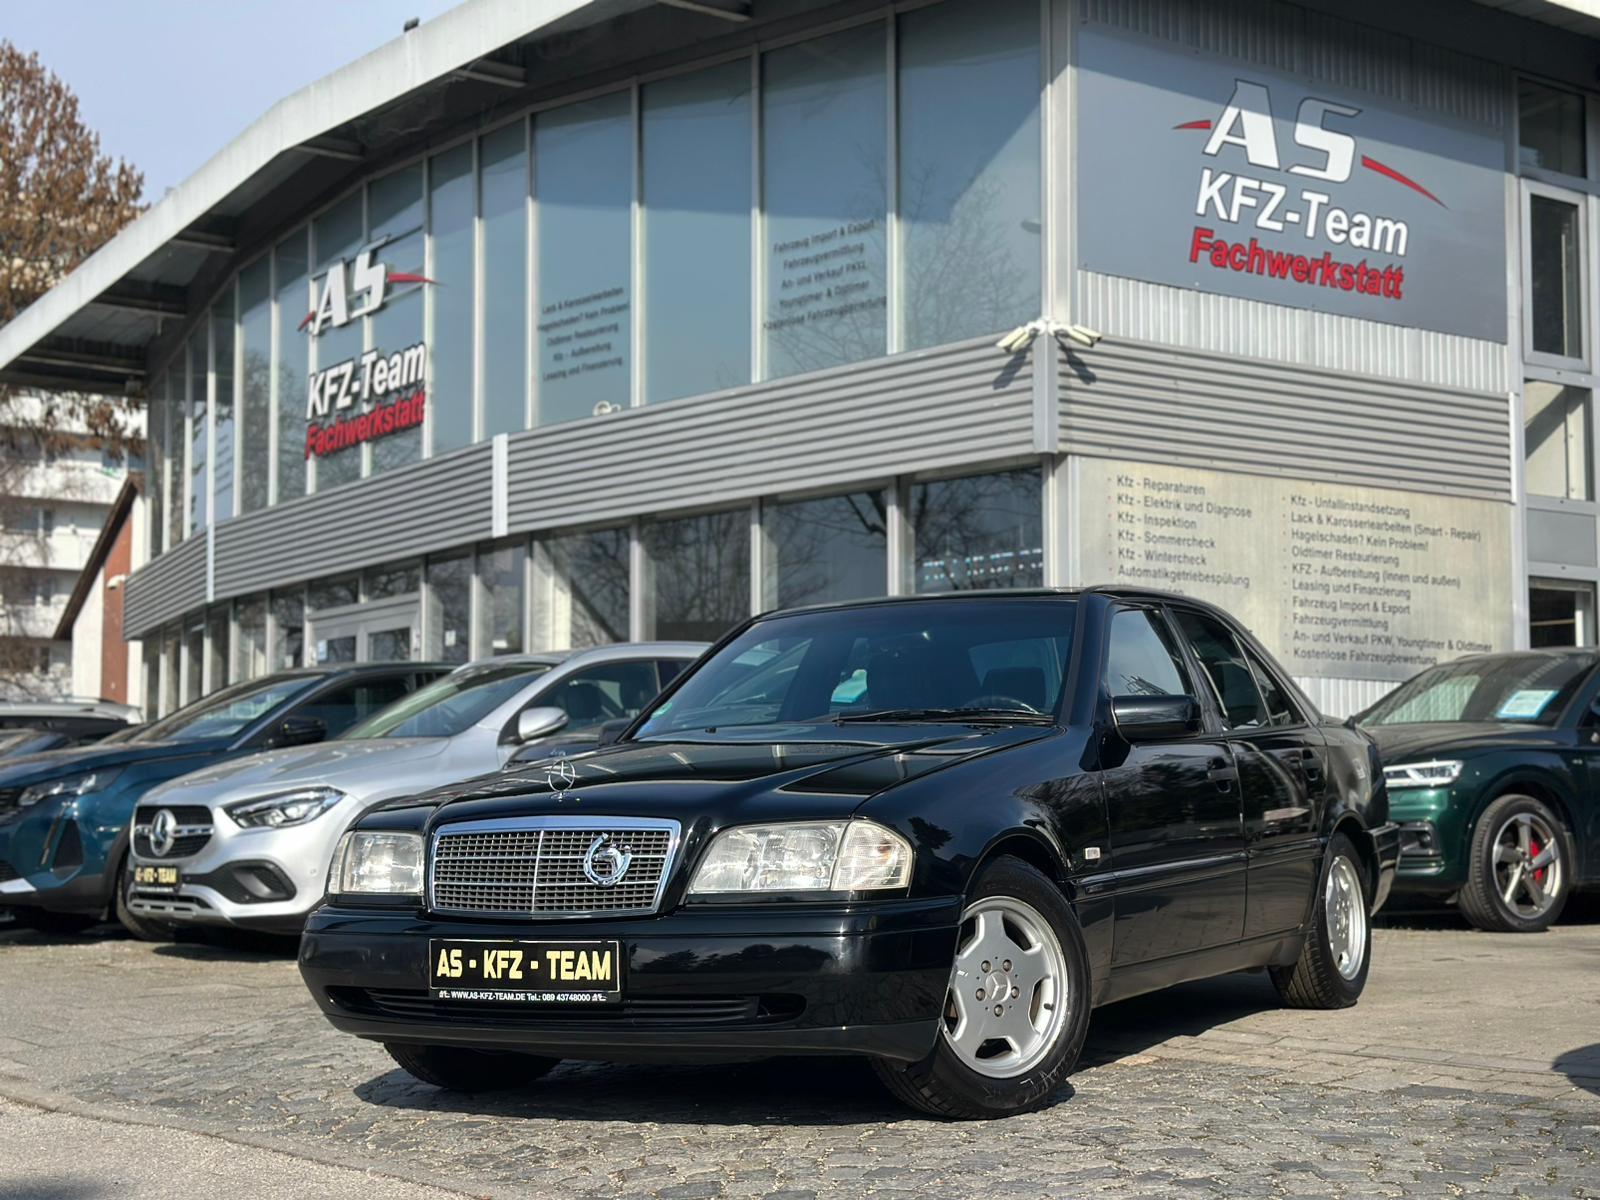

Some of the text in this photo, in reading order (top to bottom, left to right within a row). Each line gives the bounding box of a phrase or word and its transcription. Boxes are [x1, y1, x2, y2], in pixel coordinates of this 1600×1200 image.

[1202, 78, 1363, 183] AS
[1195, 167, 1408, 256] KFZ-Team
[1189, 226, 1404, 300] Fachwerkstatt
[312, 234, 391, 337] AS
[306, 342, 426, 420] KFZ-Team
[305, 390, 426, 460] Fachwerkstatt
[1144, 478, 1206, 495] Reparaturen
[1144, 496, 1181, 511] Elektrik
[1184, 501, 1204, 513] und
[1206, 502, 1252, 518] Diagnose
[1314, 496, 1410, 519] Unfallinstandsetzung
[1144, 514, 1197, 529] Inspektion
[1290, 512, 1313, 525] Lack
[1316, 514, 1323, 525] &
[1144, 532, 1216, 548] Sommercheck
[1291, 529, 1364, 546] Hagelschaden?
[1366, 535, 1387, 548] Kein
[1144, 550, 1207, 566] Wintercheck
[1292, 546, 1400, 568] Oldtimer Restaurierung
[1118, 564, 1250, 589] Automatikgetriebespülung
[1292, 564, 1312, 575] KFZ
[1320, 566, 1380, 582] Aufbereitung
[1412, 574, 1429, 585] und
[1292, 579, 1411, 600] Leasing und Finanzierung
[1292, 596, 1410, 615] Fahrzeug Import & Export
[1293, 613, 1389, 631] Fahrzeugvermittlung
[1312, 632, 1331, 643] und
[1333, 632, 1368, 645] Verkauf
[1294, 648, 1438, 666] Kostenlose Fahrzeugbewertung
[436, 949, 462, 978] AS
[483, 949, 523, 980] KFZ
[546, 950, 611, 981] TEAM
[451, 990, 526, 1001] WWW.AS-KFZ-TEAM.DE
